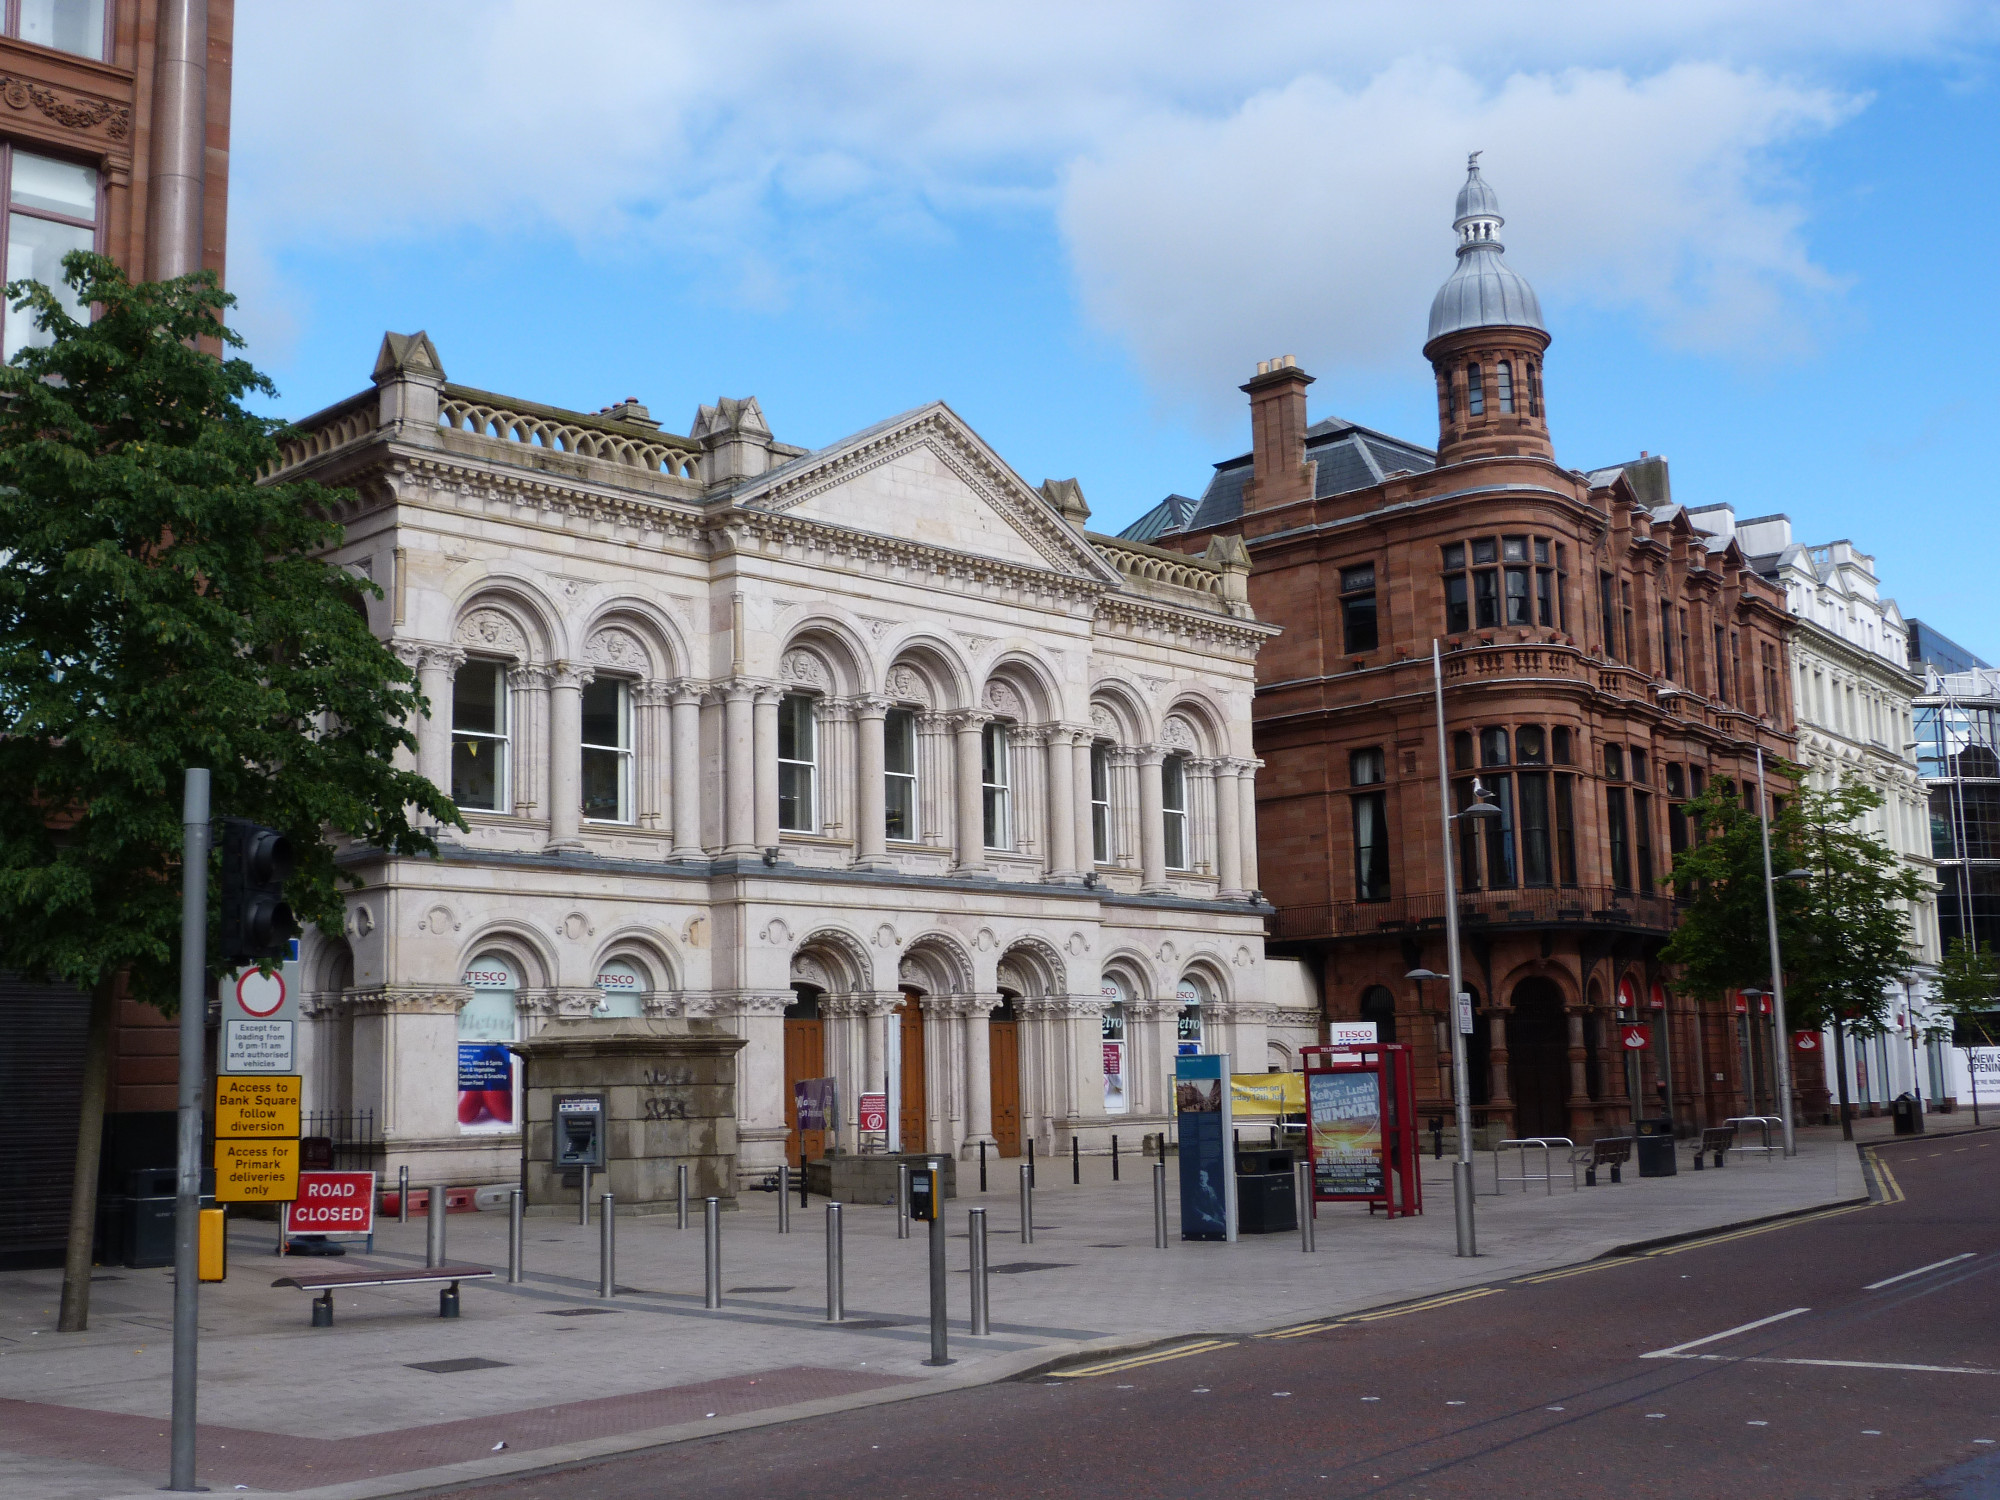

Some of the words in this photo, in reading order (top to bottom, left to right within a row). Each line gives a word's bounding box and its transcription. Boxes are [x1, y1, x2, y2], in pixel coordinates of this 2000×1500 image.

[466, 971, 507, 982] TESCO
[598, 974, 635, 985] TESCO
[1101, 987, 1117, 995] SCO
[1176, 991, 1194, 999] ESCO
[1101, 1015, 1122, 1029] etro
[1178, 1016, 1200, 1030] etro
[240, 1024, 267, 1033] Except
[269, 1024, 281, 1032] for
[235, 1033, 264, 1042] loading
[266, 1033, 285, 1041] from
[1338, 1030, 1373, 1038] TESCO
[238, 1042, 244, 1050] 6
[1320, 1045, 1350, 1053] TELEPHONE
[230, 1051, 245, 1059] and
[247, 1051, 289, 1059] authorised
[1973, 1054, 1995, 1064] NEW
[243, 1060, 276, 1068] vehicles
[1967, 1063, 2000, 1073] OPENIN
[229, 1082, 271, 1092] Access
[276, 1082, 288, 1093] to
[1249, 1085, 1268, 1094] open
[1310, 1088, 1340, 1102] Kellys
[1346, 1082, 1374, 1096] Lush!
[219, 1095, 250, 1106] Bank
[255, 1095, 297, 1107] Square
[1252, 1093, 1268, 1101] 12th
[1338, 1098, 1351, 1106] ALL
[1353, 1094, 1376, 1104] AREAS
[239, 1108, 277, 1119] follow
[1313, 1101, 1378, 1123] SUMMER
[230, 1121, 285, 1132] diversion
[227, 1146, 268, 1157] Access
[272, 1146, 289, 1157] for
[1341, 1147, 1373, 1157] SATURDAY
[235, 1159, 281, 1169] Primark
[229, 1172, 285, 1182] deliveries
[244, 1185, 269, 1196] only
[308, 1183, 355, 1197] ROAD
[295, 1207, 364, 1221] CLOSED
